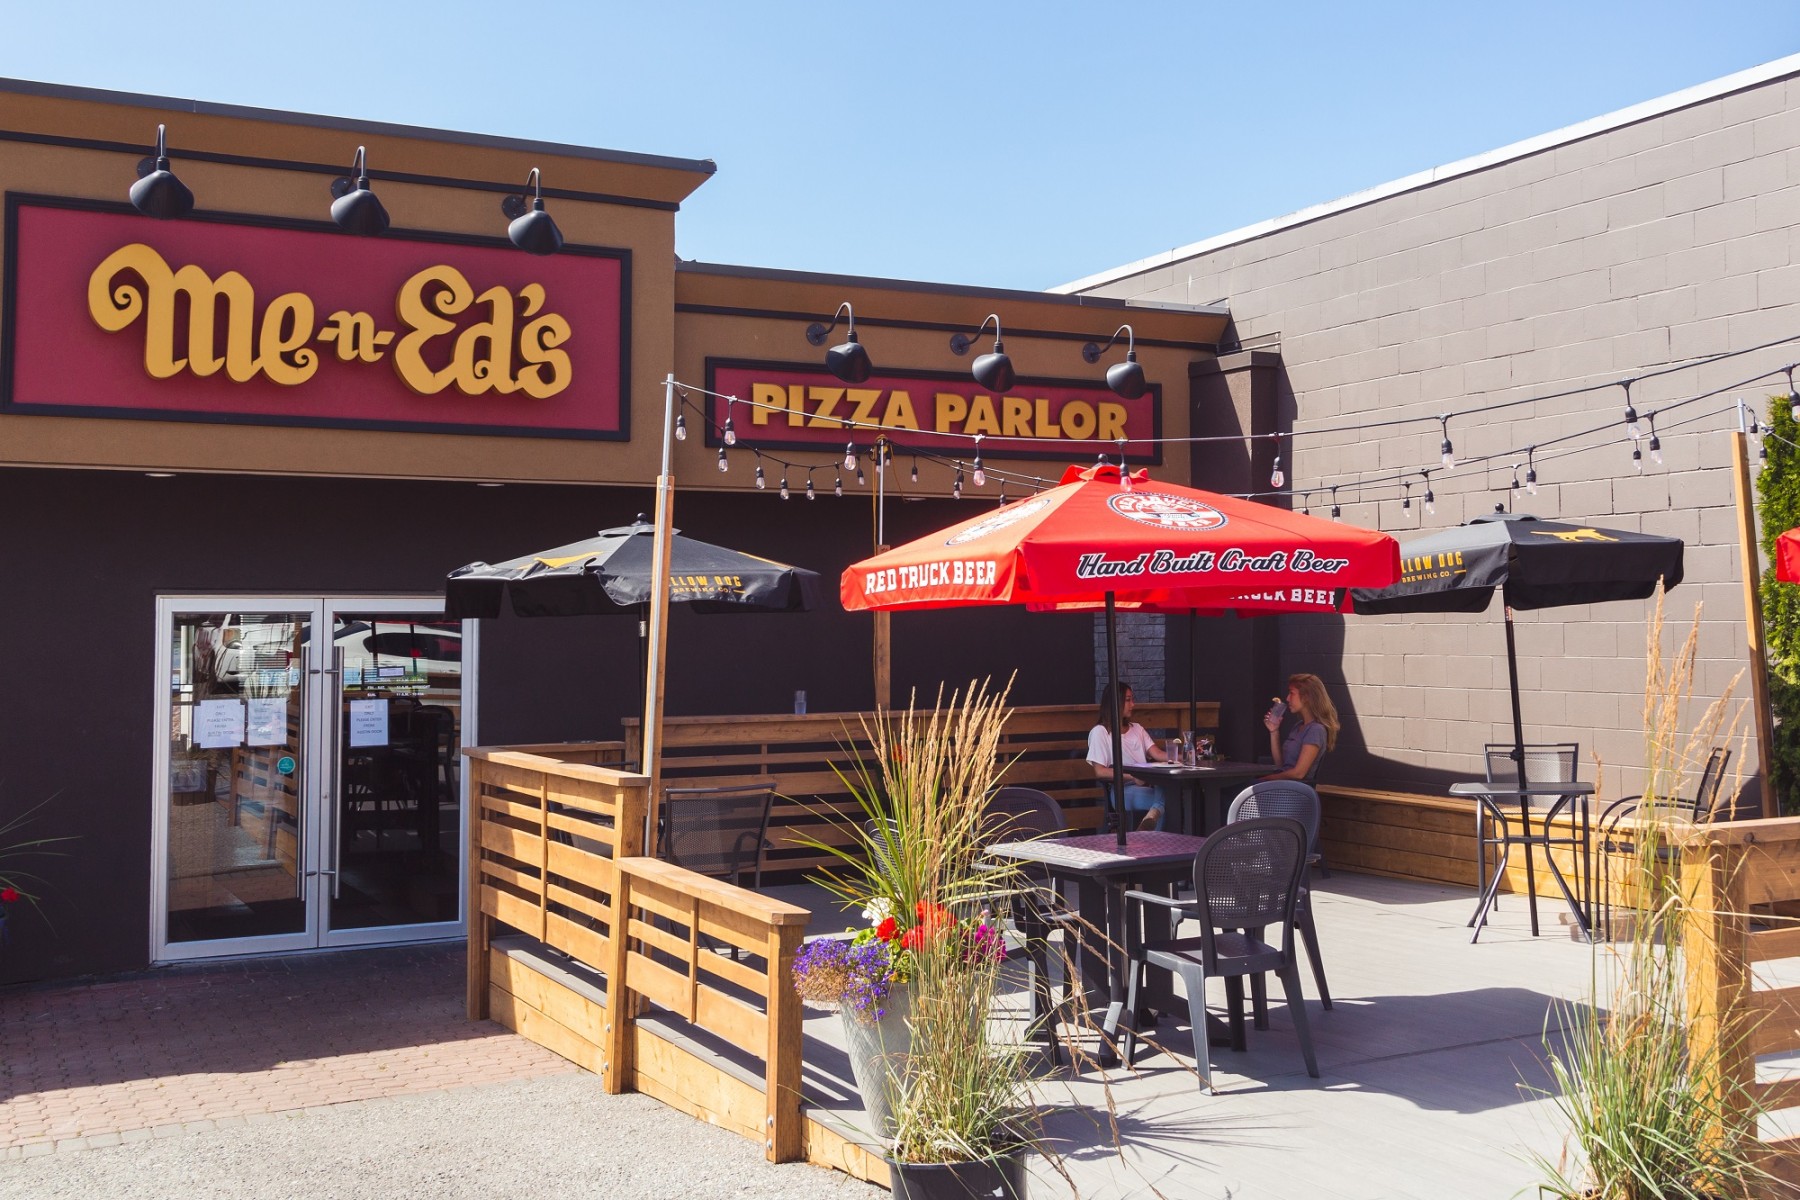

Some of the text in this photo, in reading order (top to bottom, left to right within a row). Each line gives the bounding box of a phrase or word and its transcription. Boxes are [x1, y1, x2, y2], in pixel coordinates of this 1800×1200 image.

[752, 383, 1129, 441] PIZZA PARLOR
[1077, 548, 1349, 579] Hand Built Craft Beer
[1400, 551, 1463, 574] LLOW DOG
[670, 576, 742, 587] LLOW DOG
[865, 560, 996, 595] RED TRUCK BEER
[1402, 572, 1438, 583] BREWING
